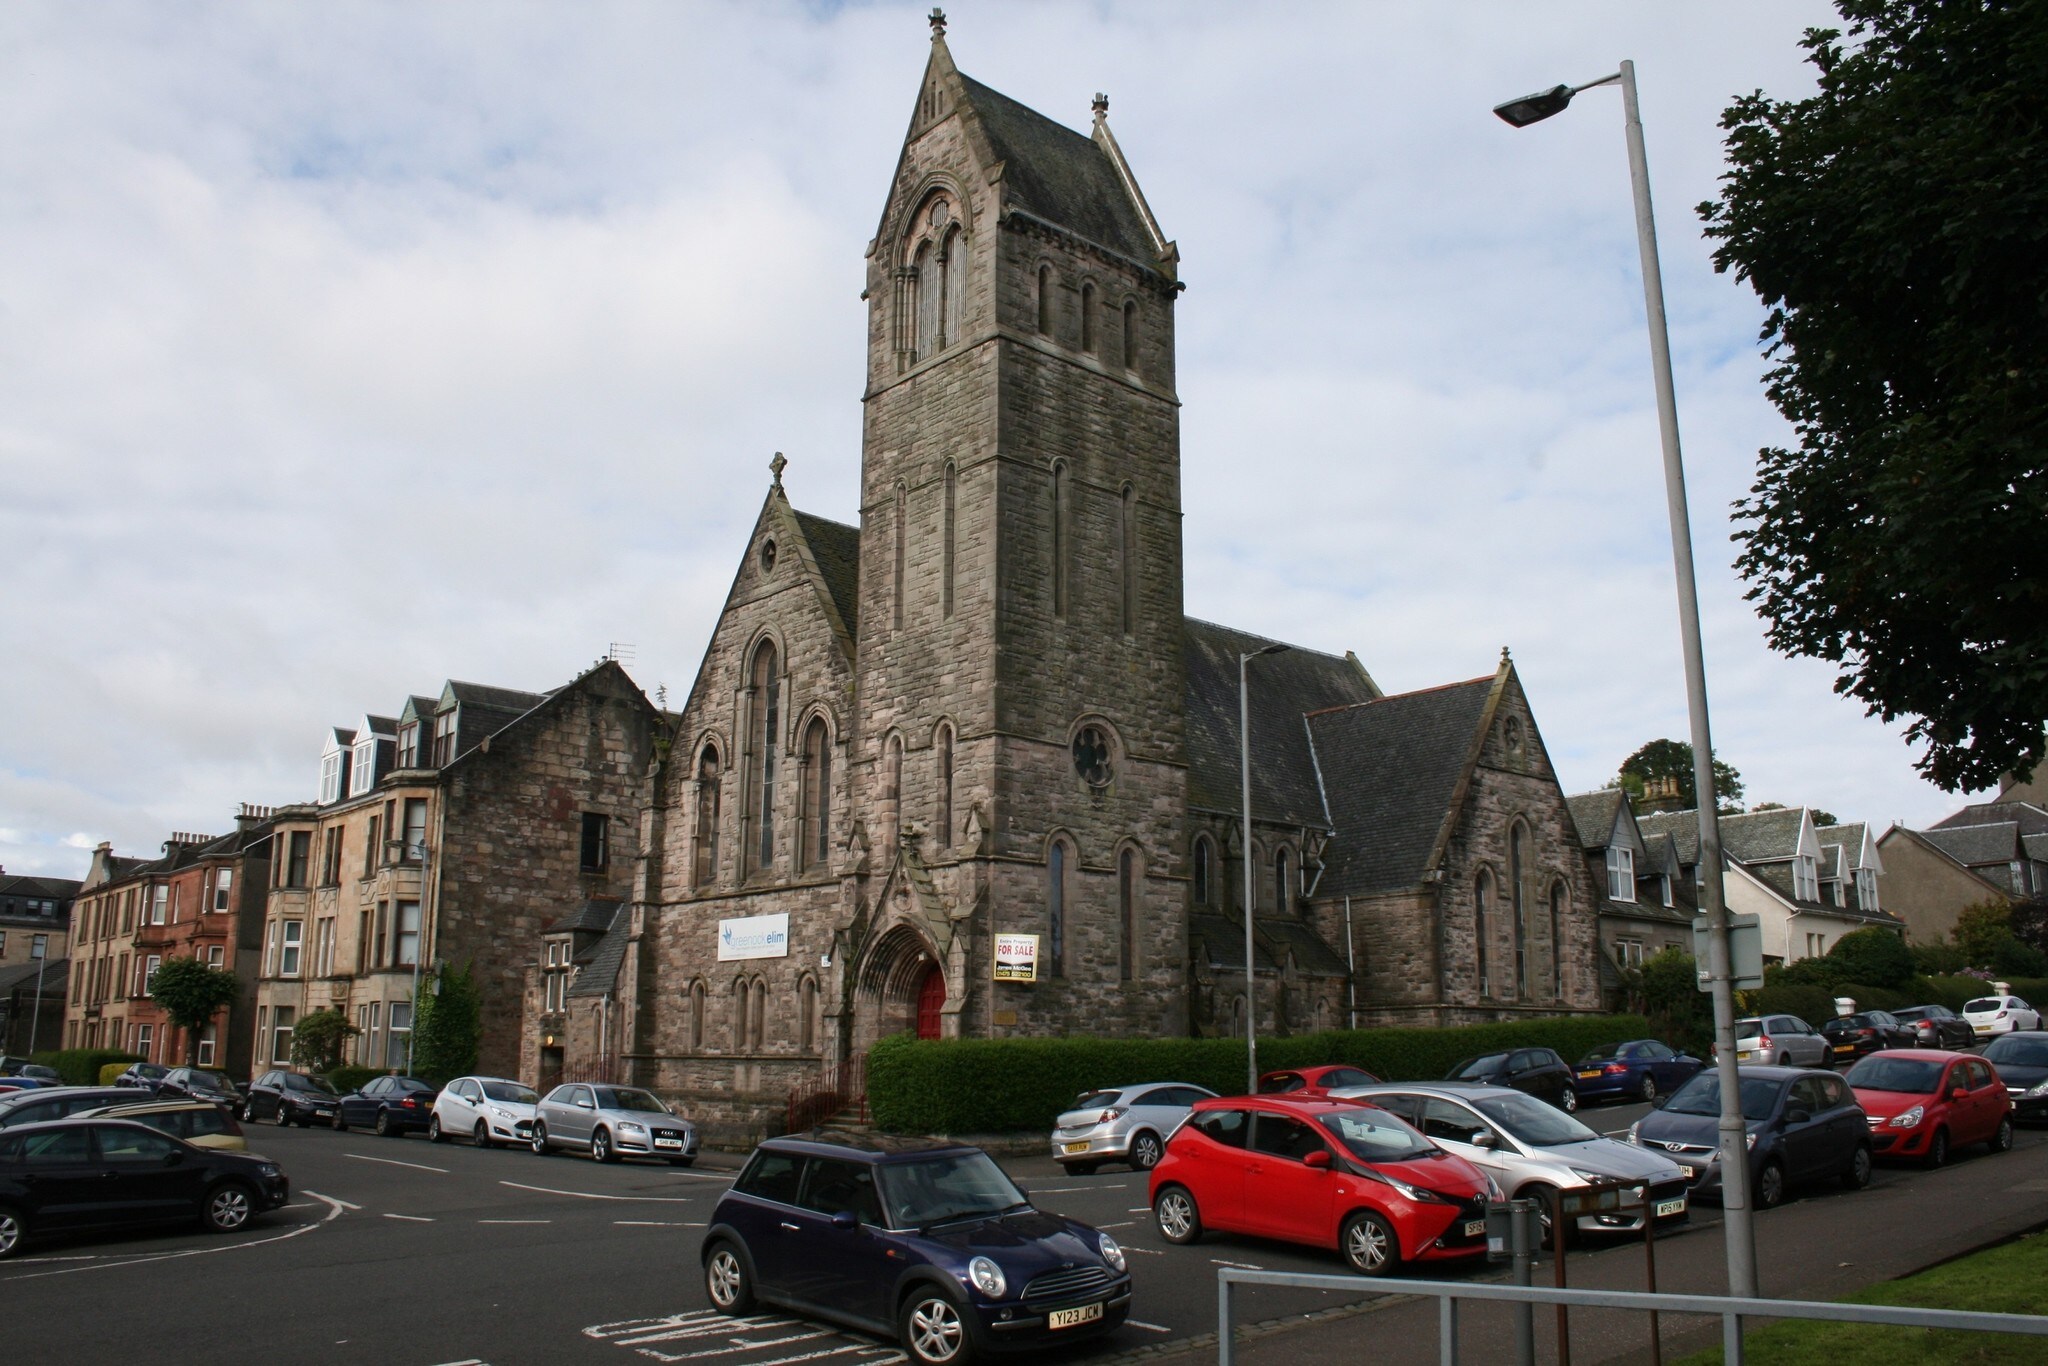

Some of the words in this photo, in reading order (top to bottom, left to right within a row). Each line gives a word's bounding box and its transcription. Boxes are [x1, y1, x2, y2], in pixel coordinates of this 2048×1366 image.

[766, 930, 784, 944] elim
[998, 945, 1012, 955] FOR
[1014, 945, 1034, 956] SALE
[1056, 1310, 1080, 1325] Y123
